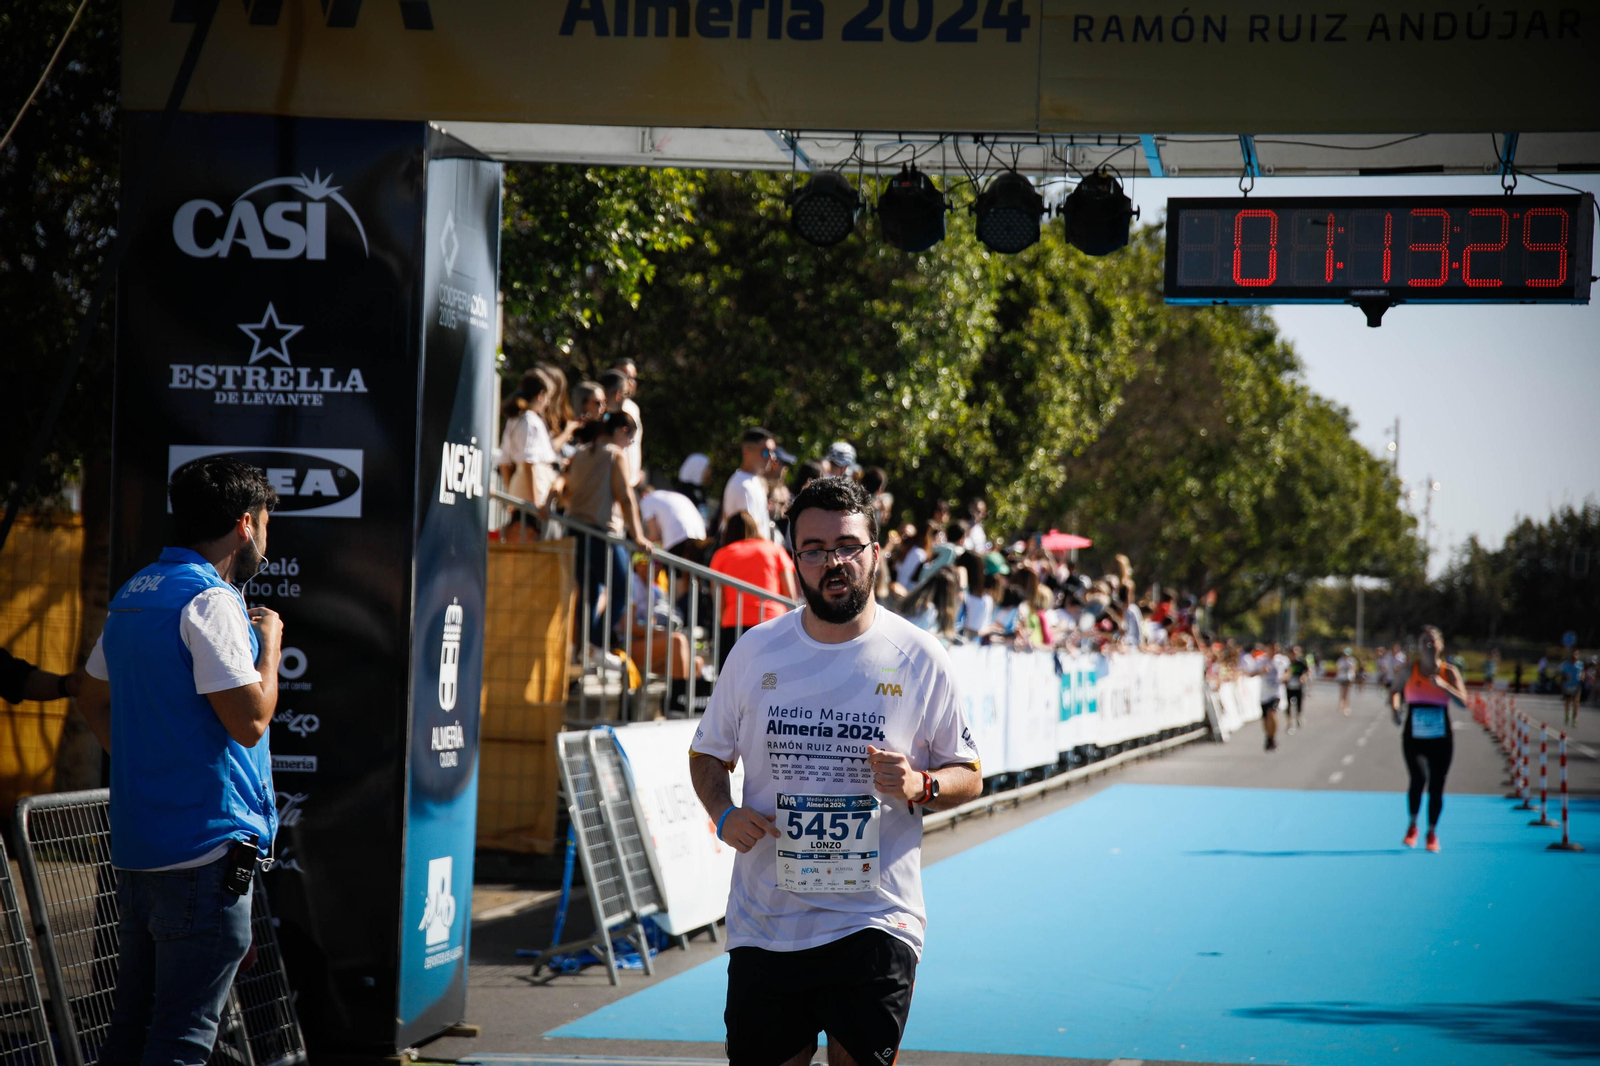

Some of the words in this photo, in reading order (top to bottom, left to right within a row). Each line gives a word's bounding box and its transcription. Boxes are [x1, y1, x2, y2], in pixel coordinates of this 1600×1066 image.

[842, 0, 1031, 43] 2024
[1073, 7, 1227, 43] RAMÓN
[1249, 14, 1348, 42] RUIZ
[1367, 4, 1582, 42] ANDÚJAR
[172, 198, 327, 260] CASI
[168, 363, 369, 393] ESTRELLA
[214, 391, 240, 404] DE
[242, 391, 324, 407] LEVANTE
[266, 467, 341, 497] EA
[259, 557, 300, 577] celó
[237, 579, 273, 598] abo
[277, 578, 302, 598] de
[762, 672, 777, 686] 25
[767, 705, 813, 719] Medio
[819, 708, 886, 725] Maratón
[766, 719, 833, 738] Almería
[837, 723, 886, 742] 2024
[767, 740, 803, 750] RAMÓN
[807, 742, 832, 752] RUIZ
[836, 744, 885, 755] ANDÚ
[271, 756, 315, 770] lmería
[786, 811, 872, 841] 5457
[810, 841, 842, 850] LONZO
